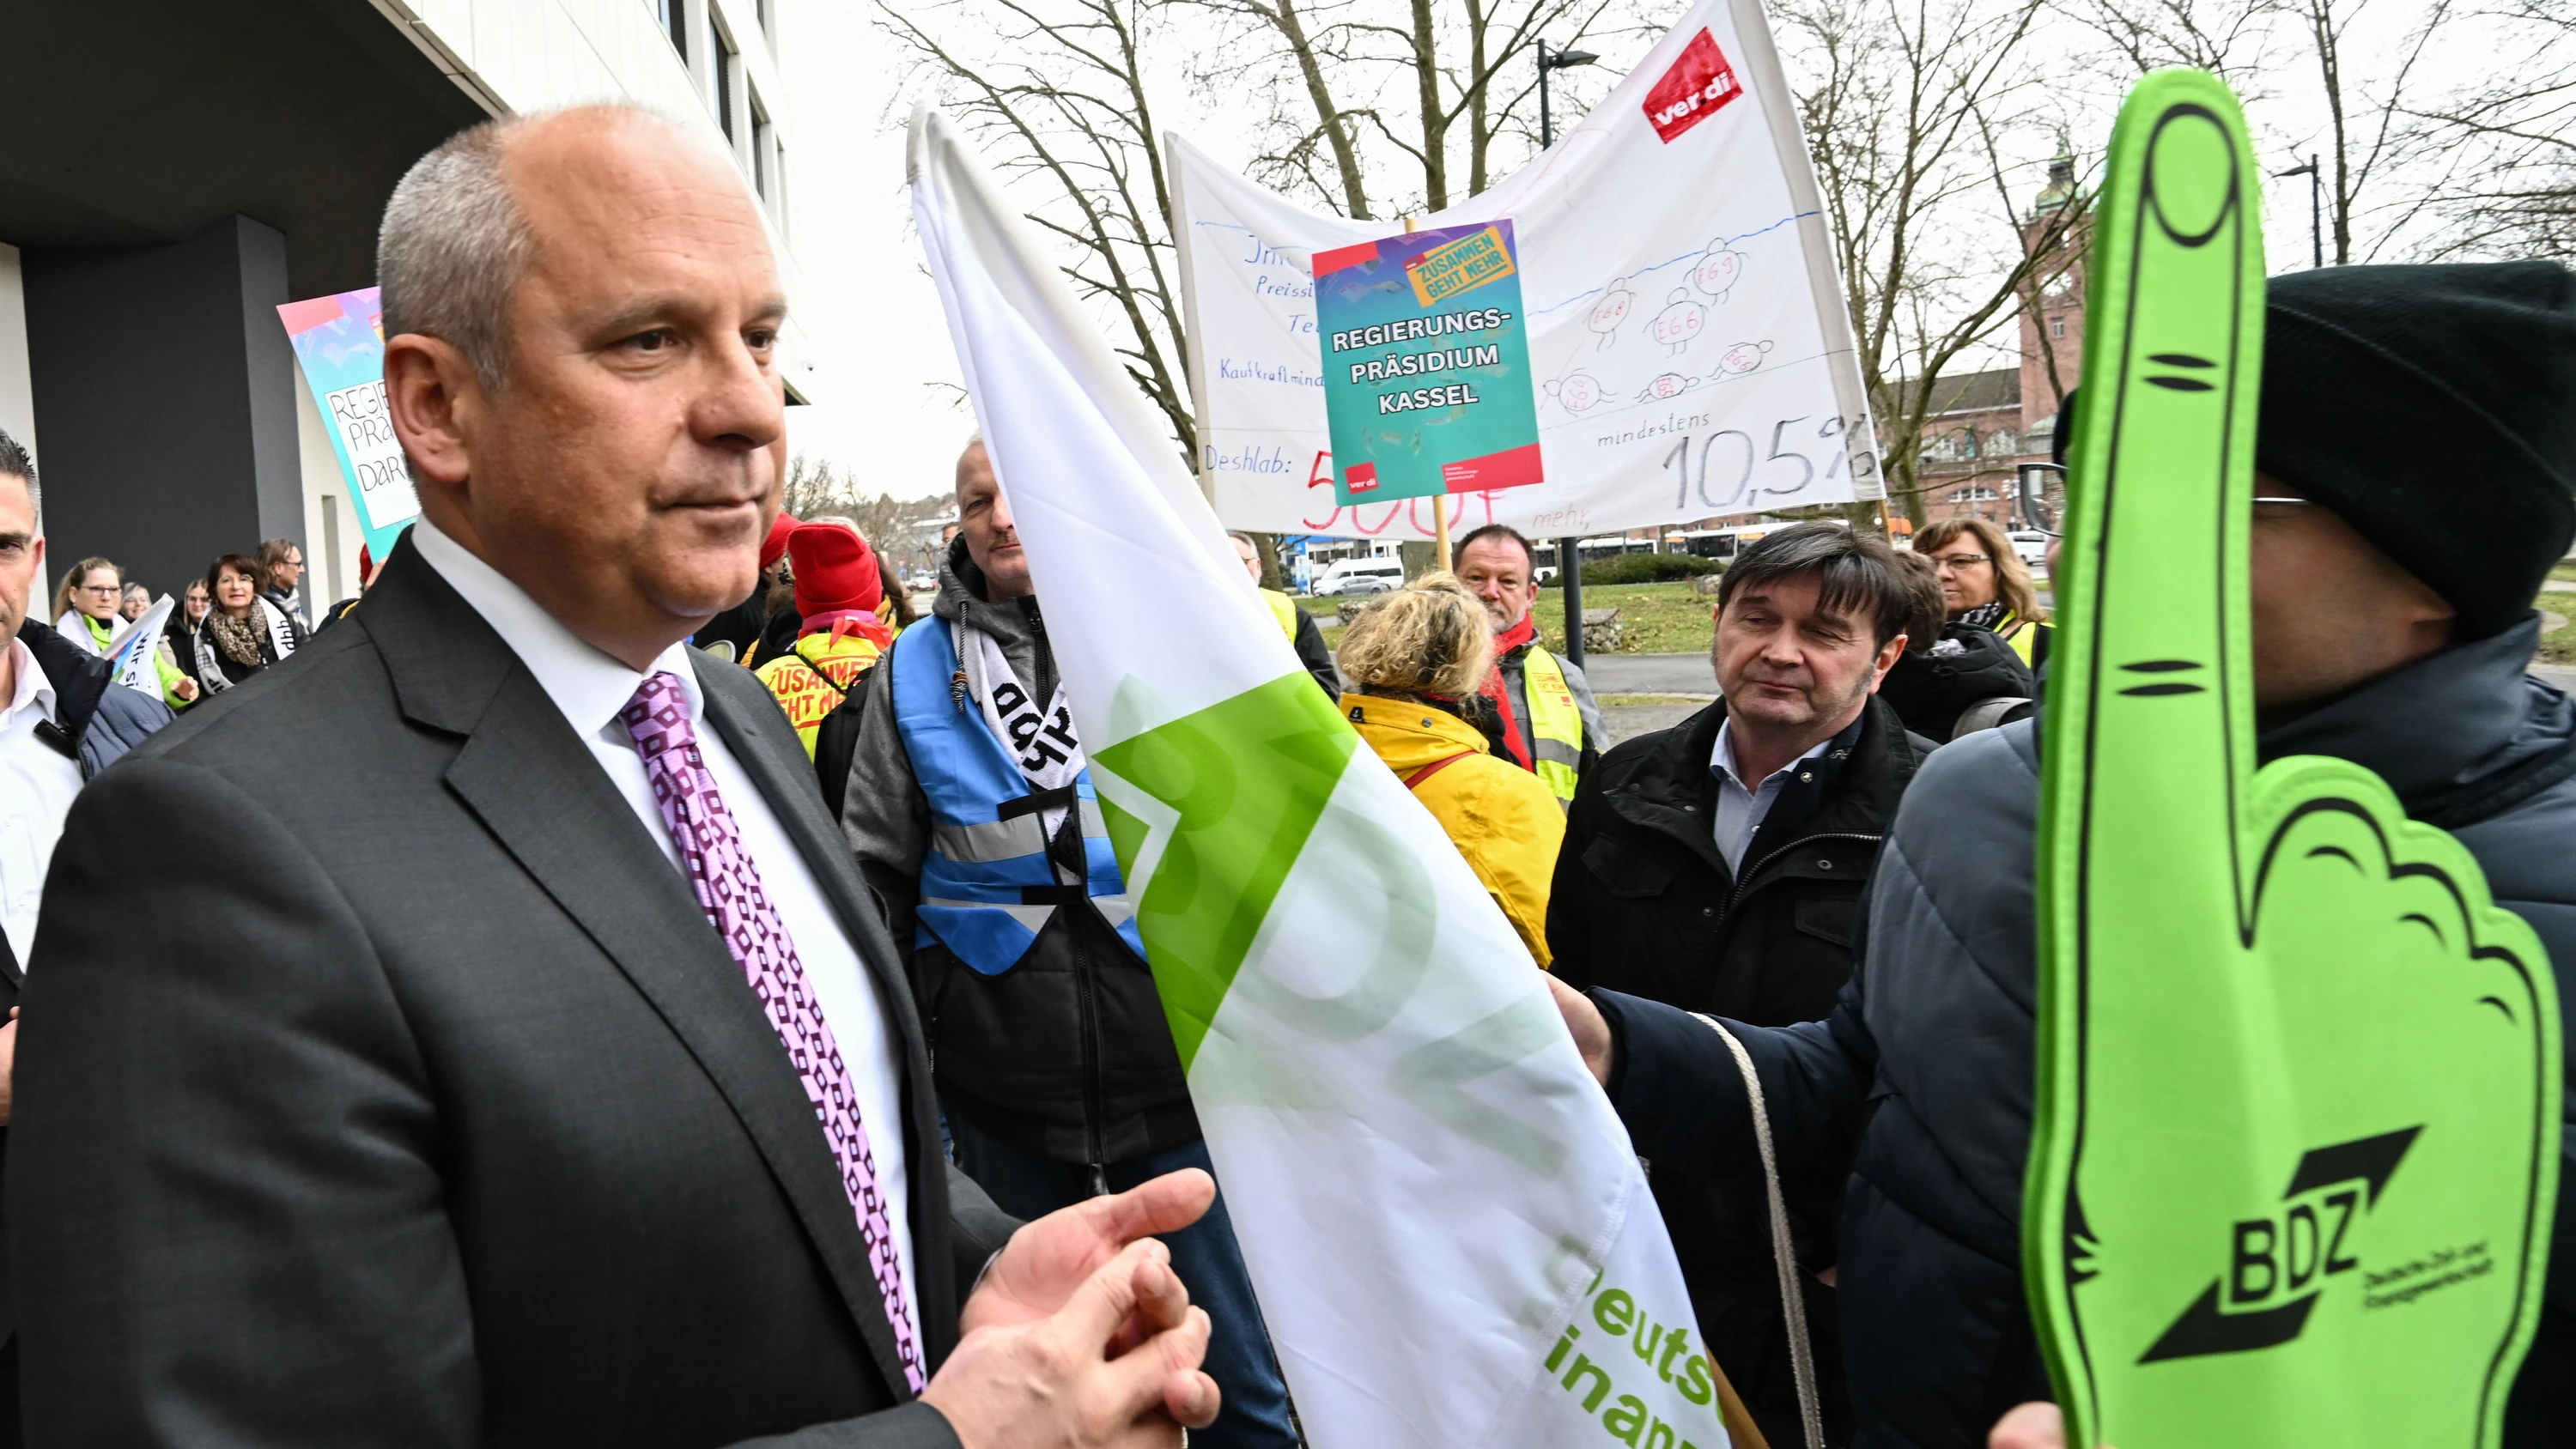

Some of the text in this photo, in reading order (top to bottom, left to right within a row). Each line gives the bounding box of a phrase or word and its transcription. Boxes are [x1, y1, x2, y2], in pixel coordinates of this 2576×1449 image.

[1654, 71, 1733, 126] ver.di
[1416, 233, 1496, 283] ZUSAMMEN
[1425, 250, 1506, 299] GEHT MEHR
[1332, 307, 1512, 352] REGIERUNGS-
[1220, 357, 1324, 386] Kaufkraftmind
[1350, 344, 1500, 384] PRÄSIDIUM
[329, 381, 390, 423] REGIE
[1377, 384, 1479, 415] KASSEL
[1597, 410, 1711, 447] mindestens
[1206, 445, 1291, 474] Deshlab:
[125, 632, 150, 688] Wir si
[2230, 1188, 2359, 1305] BDZ
